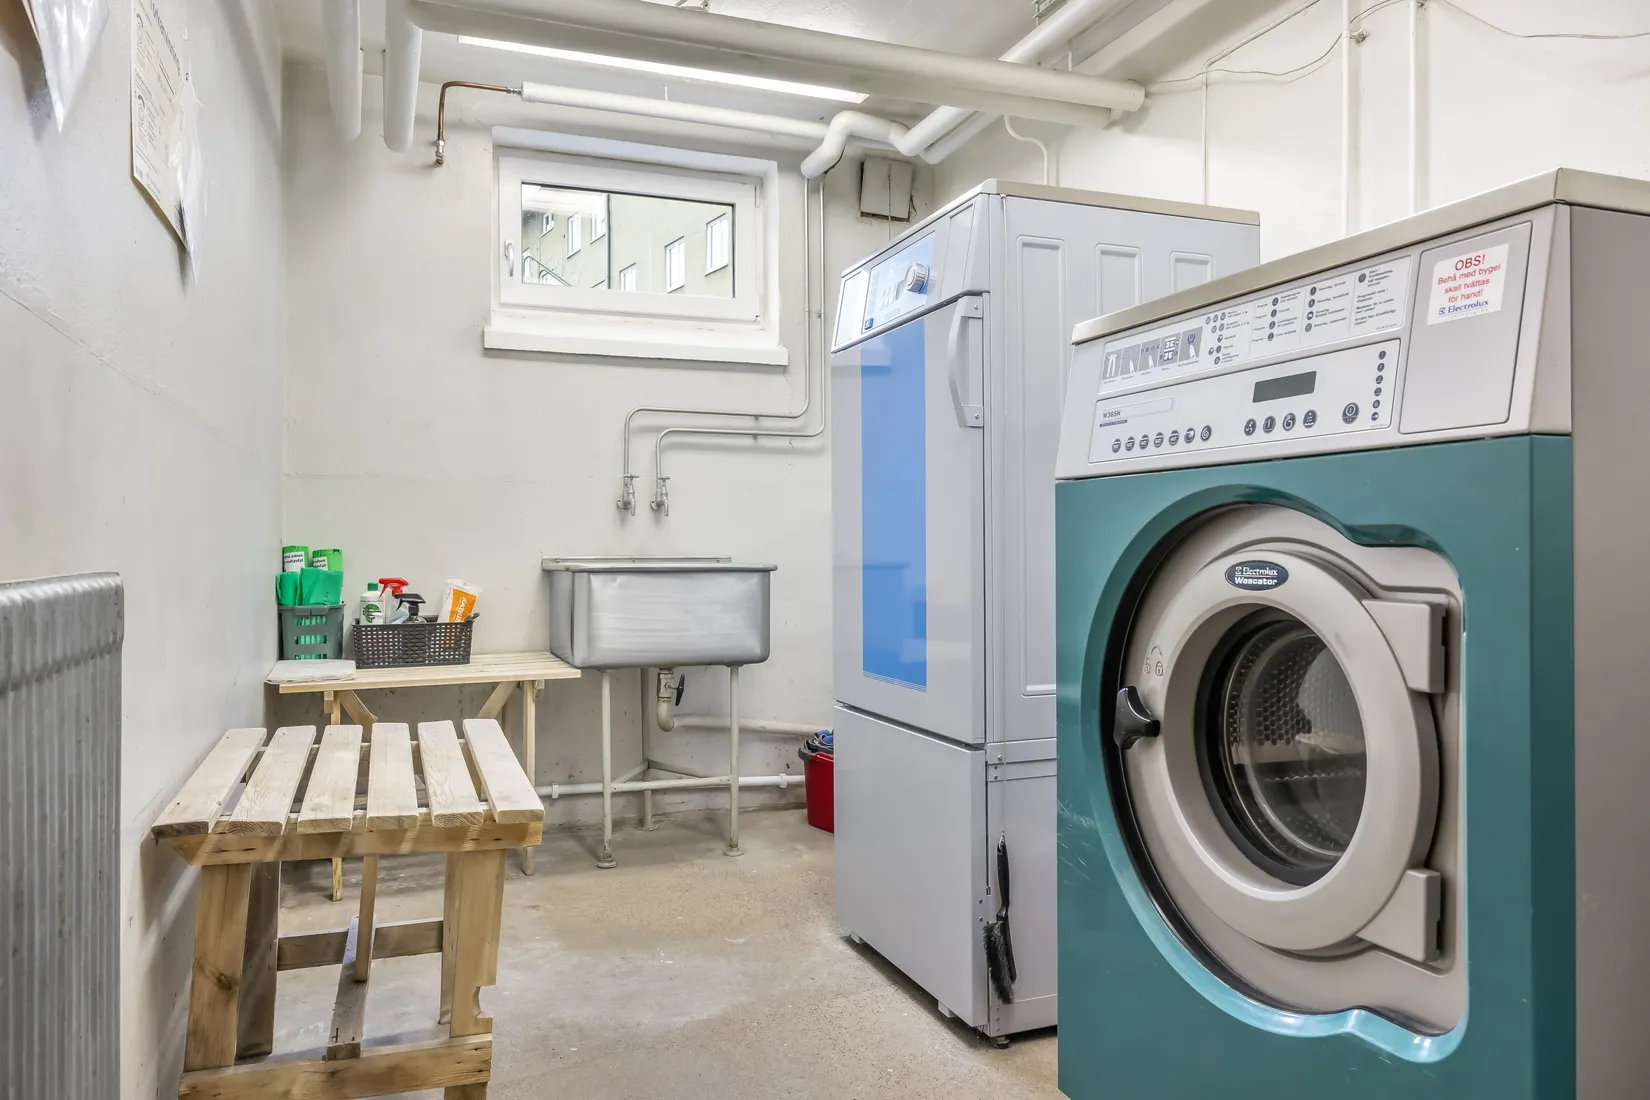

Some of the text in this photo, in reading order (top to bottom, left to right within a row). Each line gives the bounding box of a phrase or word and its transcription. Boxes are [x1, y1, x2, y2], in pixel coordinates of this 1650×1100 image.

[1455, 254, 1485, 271] OBS!
[1438, 263, 1501, 285] Behå med bygel
[1444, 278, 1490, 294] skall tvättas
[1448, 289, 1484, 304] för hand!
[1448, 299, 1489, 314] Electrolux
[1242, 566, 1278, 576] Electrolux
[1234, 577, 1278, 585] Wascator
